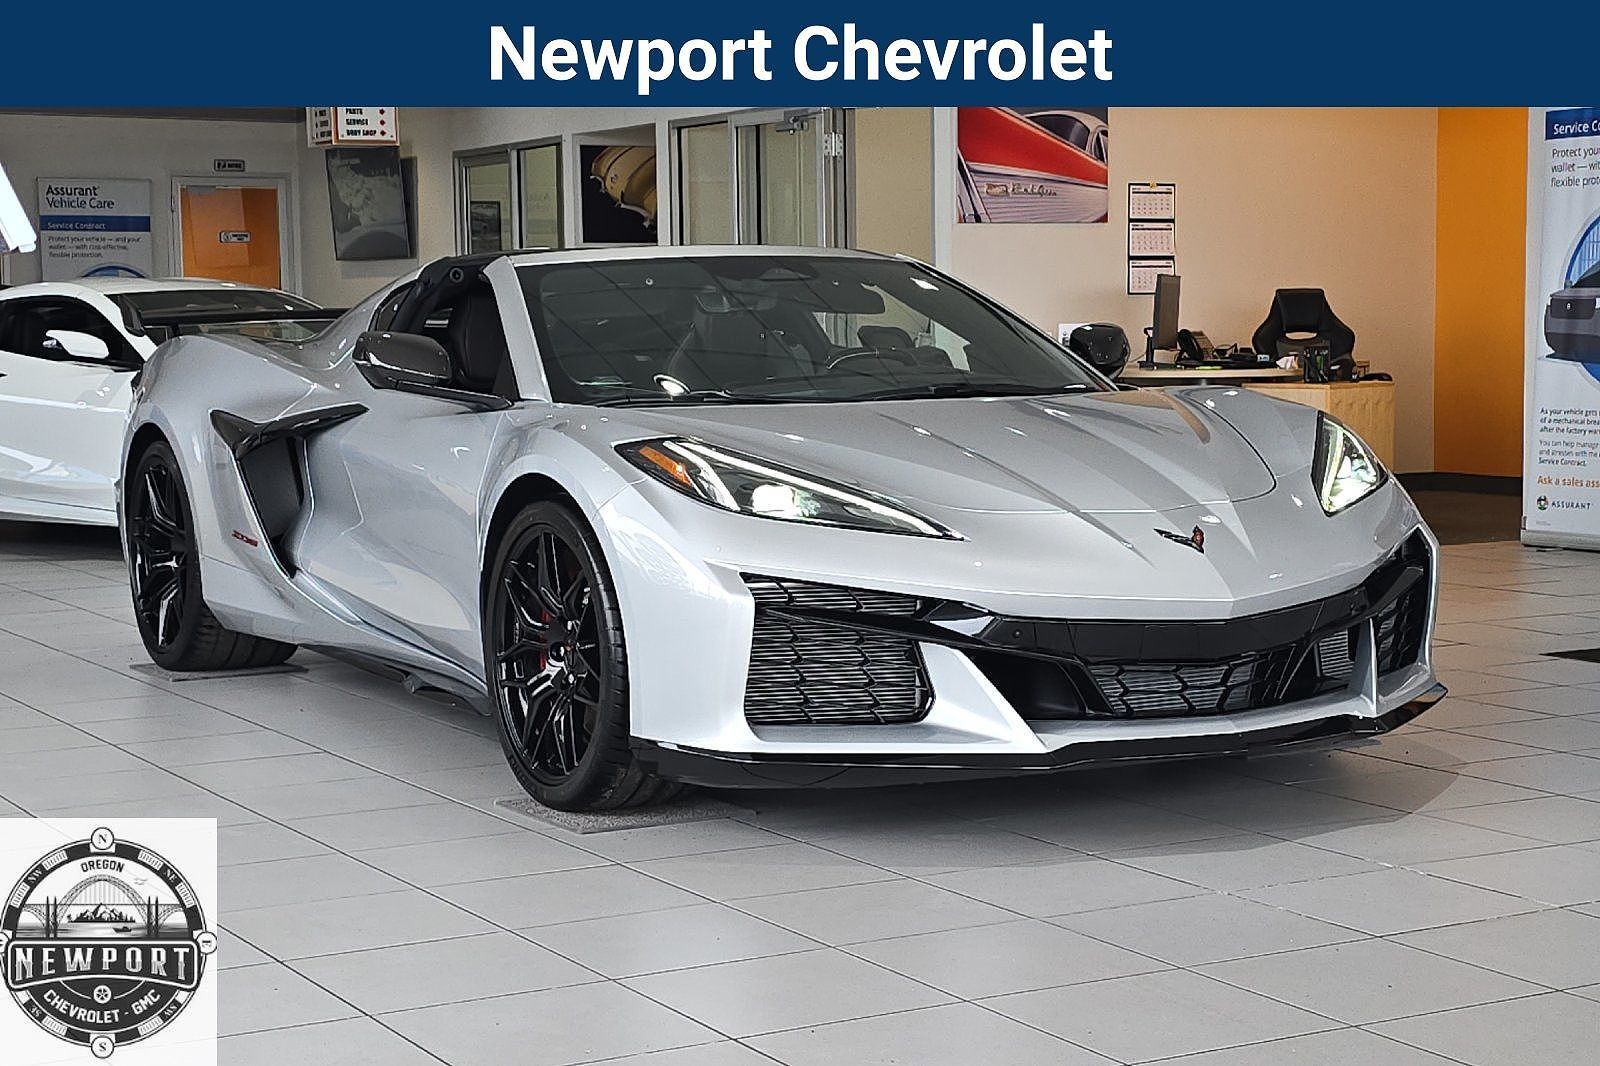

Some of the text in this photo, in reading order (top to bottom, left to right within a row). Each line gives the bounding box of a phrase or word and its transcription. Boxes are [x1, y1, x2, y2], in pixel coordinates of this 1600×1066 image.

[345, 118, 369, 126] SERVICE
[346, 129, 377, 137] BODY SHOP
[1553, 121, 1590, 135] Service
[1552, 147, 1582, 159] Protect
[1551, 162, 1575, 173] wallet
[1550, 177, 1581, 187] flexible
[46, 185, 98, 196] Assurant
[46, 196, 115, 210] Vehicle Care
[47, 222, 106, 231] Service Contract
[1549, 408, 1562, 416] your
[1553, 417, 1586, 425] mechanical
[1566, 427, 1587, 436] factory
[1538, 457, 1559, 465] Service
[1537, 475, 1553, 485] Ask
[1562, 476, 1584, 487] sales
[1551, 500, 1591, 510] ASSURANT
